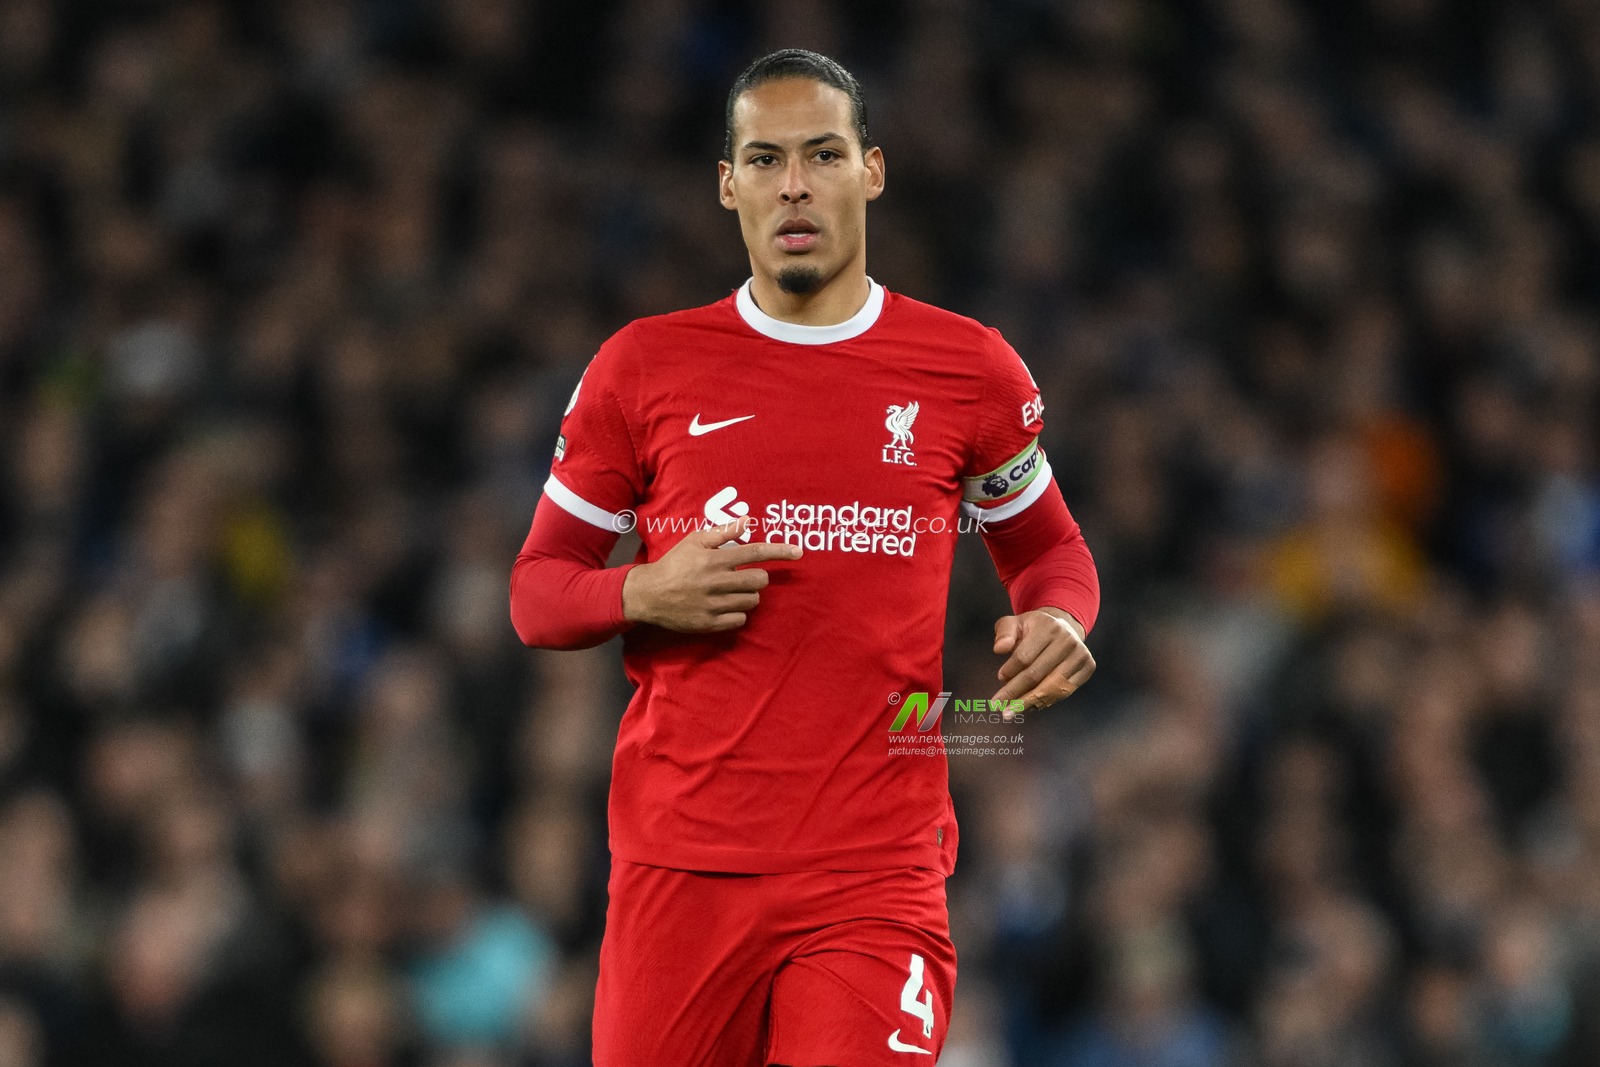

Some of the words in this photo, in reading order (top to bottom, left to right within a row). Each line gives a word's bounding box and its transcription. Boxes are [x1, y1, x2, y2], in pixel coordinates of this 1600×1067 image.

[1009, 449, 1039, 481] Cap
[765, 499, 913, 533] standard
[765, 524, 917, 557] chartered
[900, 953, 934, 1040] 4
